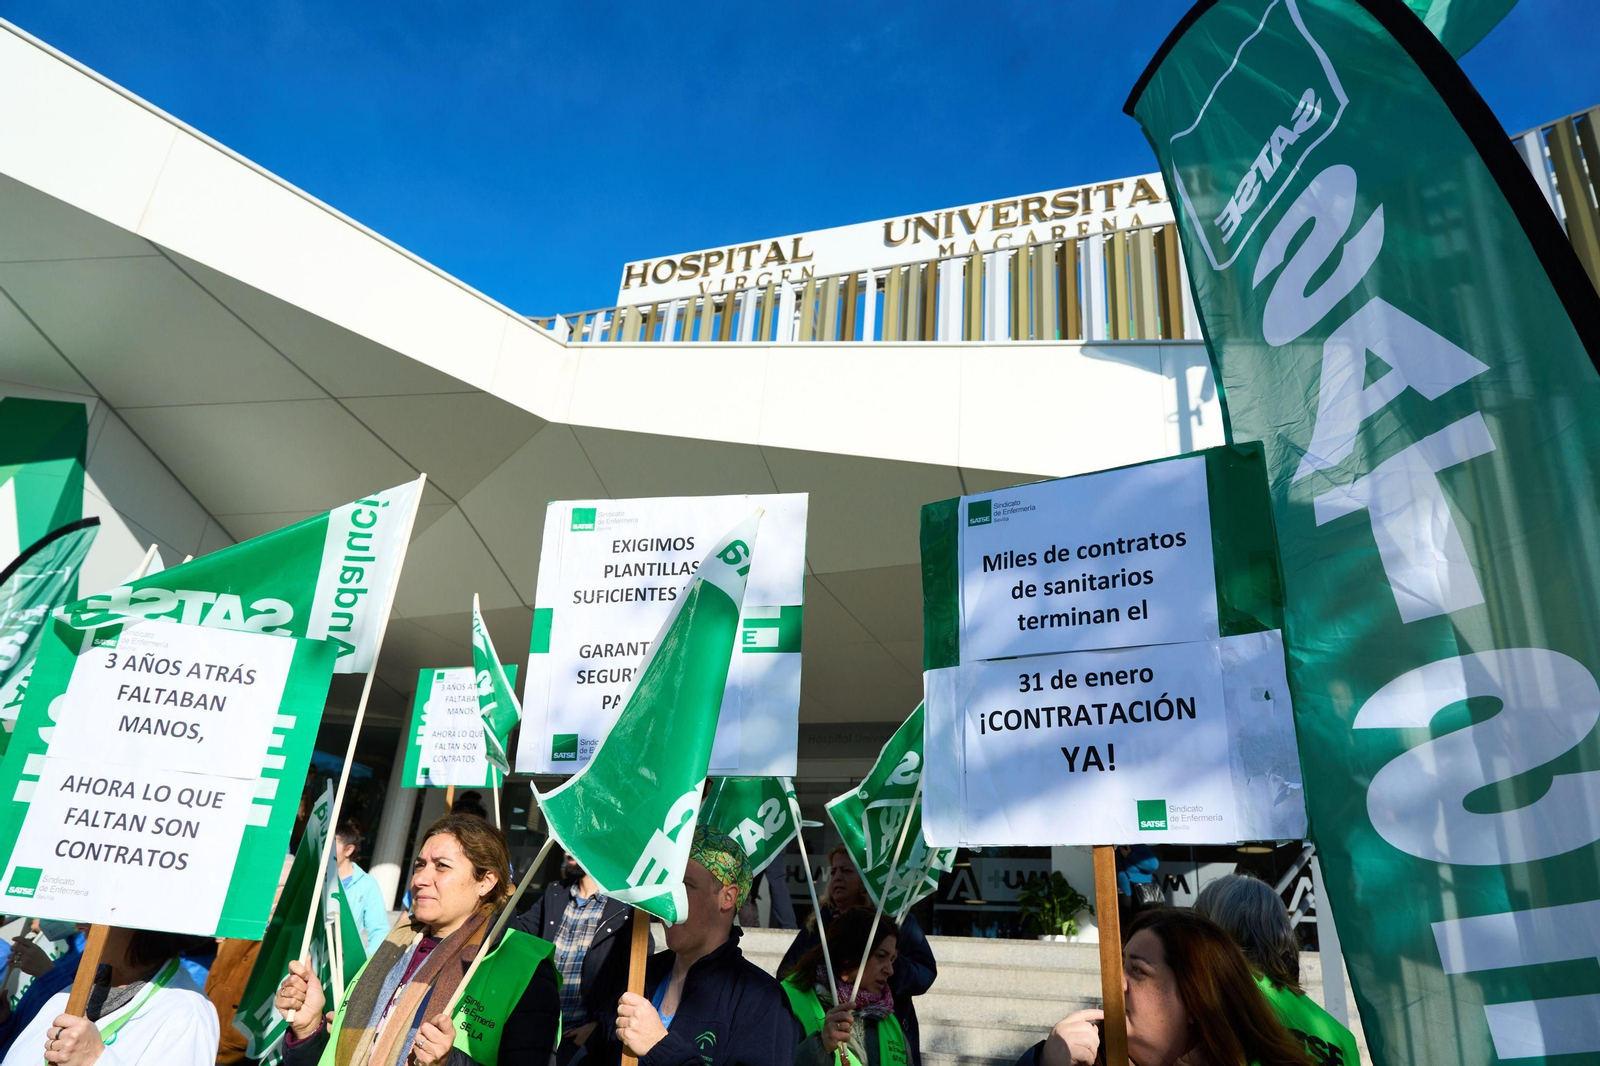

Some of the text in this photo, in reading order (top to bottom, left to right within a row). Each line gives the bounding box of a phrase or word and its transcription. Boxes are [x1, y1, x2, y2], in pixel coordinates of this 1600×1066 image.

[623, 177, 1166, 290] HOSPITAL UNIVERSITA
[699, 212, 1144, 295] VIRGEN MACARENA
[993, 500, 1021, 509] Sindicato
[1003, 505, 1036, 515] Enfermería
[606, 517, 639, 525] Enfermería
[970, 516, 990, 525] SATSE
[612, 536, 695, 554] EXIGIMOS
[982, 530, 1187, 573] Miles de contratos
[603, 560, 700, 579] PLANTILLAS
[1011, 568, 1154, 600] de sanitarios
[573, 586, 677, 605] SUFICIENTES
[1017, 600, 1148, 632] terminan el
[579, 641, 653, 659] GARANT
[105, 652, 257, 686] 3 AÑOS ATRÁS
[576, 668, 637, 685] SEGUR
[1018, 666, 1154, 693] 31 de enero
[117, 684, 227, 713] FALTABAN
[979, 692, 1197, 735] ¡CONTRATACIÓN
[118, 715, 205, 743] MANOS,
[432, 730, 456, 738] AHORA
[457, 730, 467, 738] LO
[434, 742, 477, 750] FALTAN SON
[808, 733, 852, 745] Hospital
[433, 755, 475, 763] CONTRATOS
[1061, 743, 1116, 773] YA!
[60, 774, 226, 810] AHORA LO QUE
[1169, 805, 1204, 813] Sindicato
[1181, 814, 1223, 822] Enfermería
[63, 807, 201, 839] FALTAN SON
[1140, 820, 1166, 828] SATSE
[54, 839, 190, 872] CONTRATOS
[42, 875, 75, 886] Sindicato
[8, 886, 35, 896] SATSE
[50, 885, 90, 897] Enfermería
